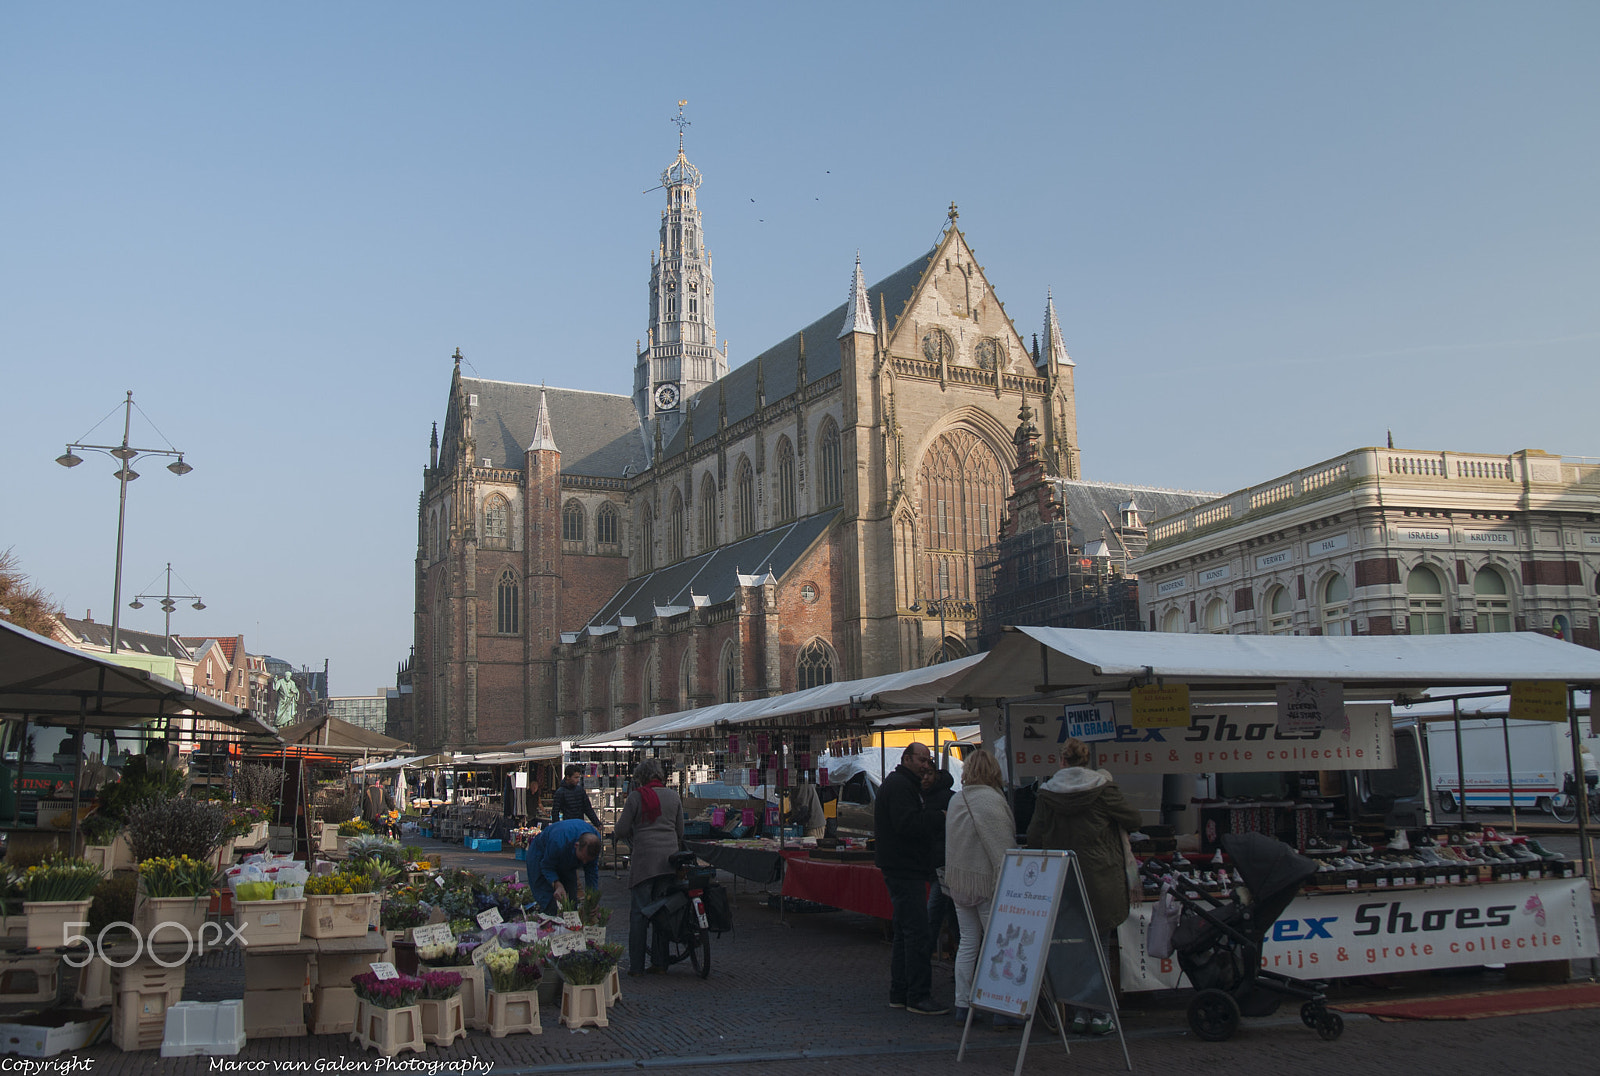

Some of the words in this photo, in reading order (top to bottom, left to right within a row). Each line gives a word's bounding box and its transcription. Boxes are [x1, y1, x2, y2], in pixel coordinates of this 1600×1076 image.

[1408, 531, 1439, 540] ISRAELS
[1470, 533, 1508, 542] KRUYDER
[1322, 540, 1335, 550] HAL
[1263, 553, 1285, 565] VERWEY
[1206, 569, 1223, 581] KUNST
[1161, 579, 1184, 591] MODERNE
[1068, 709, 1101, 724] PINNEN
[1070, 723, 1083, 737] JA
[1084, 720, 1115, 736] GRAAG
[1099, 750, 1152, 766] prijs
[1168, 749, 1180, 762] &
[1194, 748, 1252, 764] grote
[1267, 746, 1363, 761] collectie
[55, 780, 64, 790] &
[1353, 901, 1517, 936] Shoes
[1336, 946, 1350, 962] &
[1366, 941, 1433, 963] grote
[1450, 932, 1562, 954] collectie
